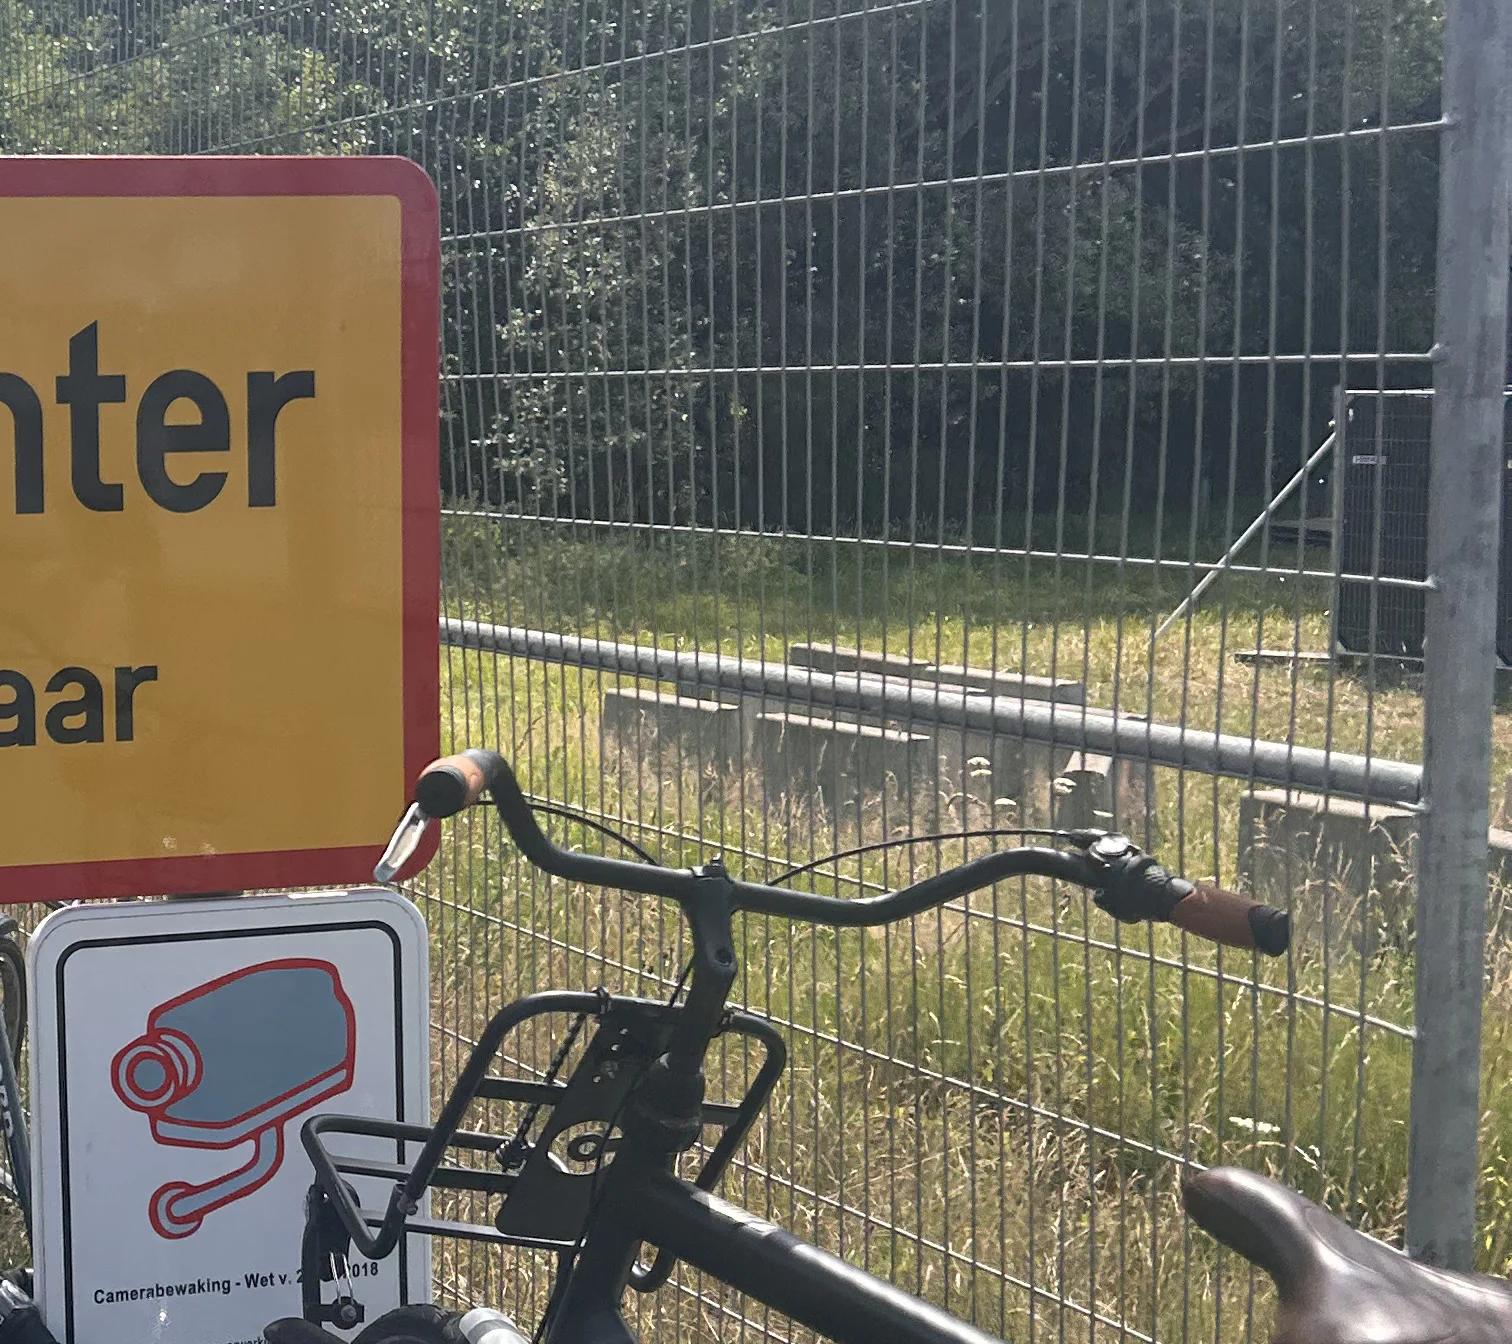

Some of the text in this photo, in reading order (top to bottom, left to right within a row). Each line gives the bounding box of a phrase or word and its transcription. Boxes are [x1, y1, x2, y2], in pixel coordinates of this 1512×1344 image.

[93, 1276, 231, 1305] Camerabewaking
[244, 1272, 275, 1288] Wet
[278, 1273, 292, 1286] v.
